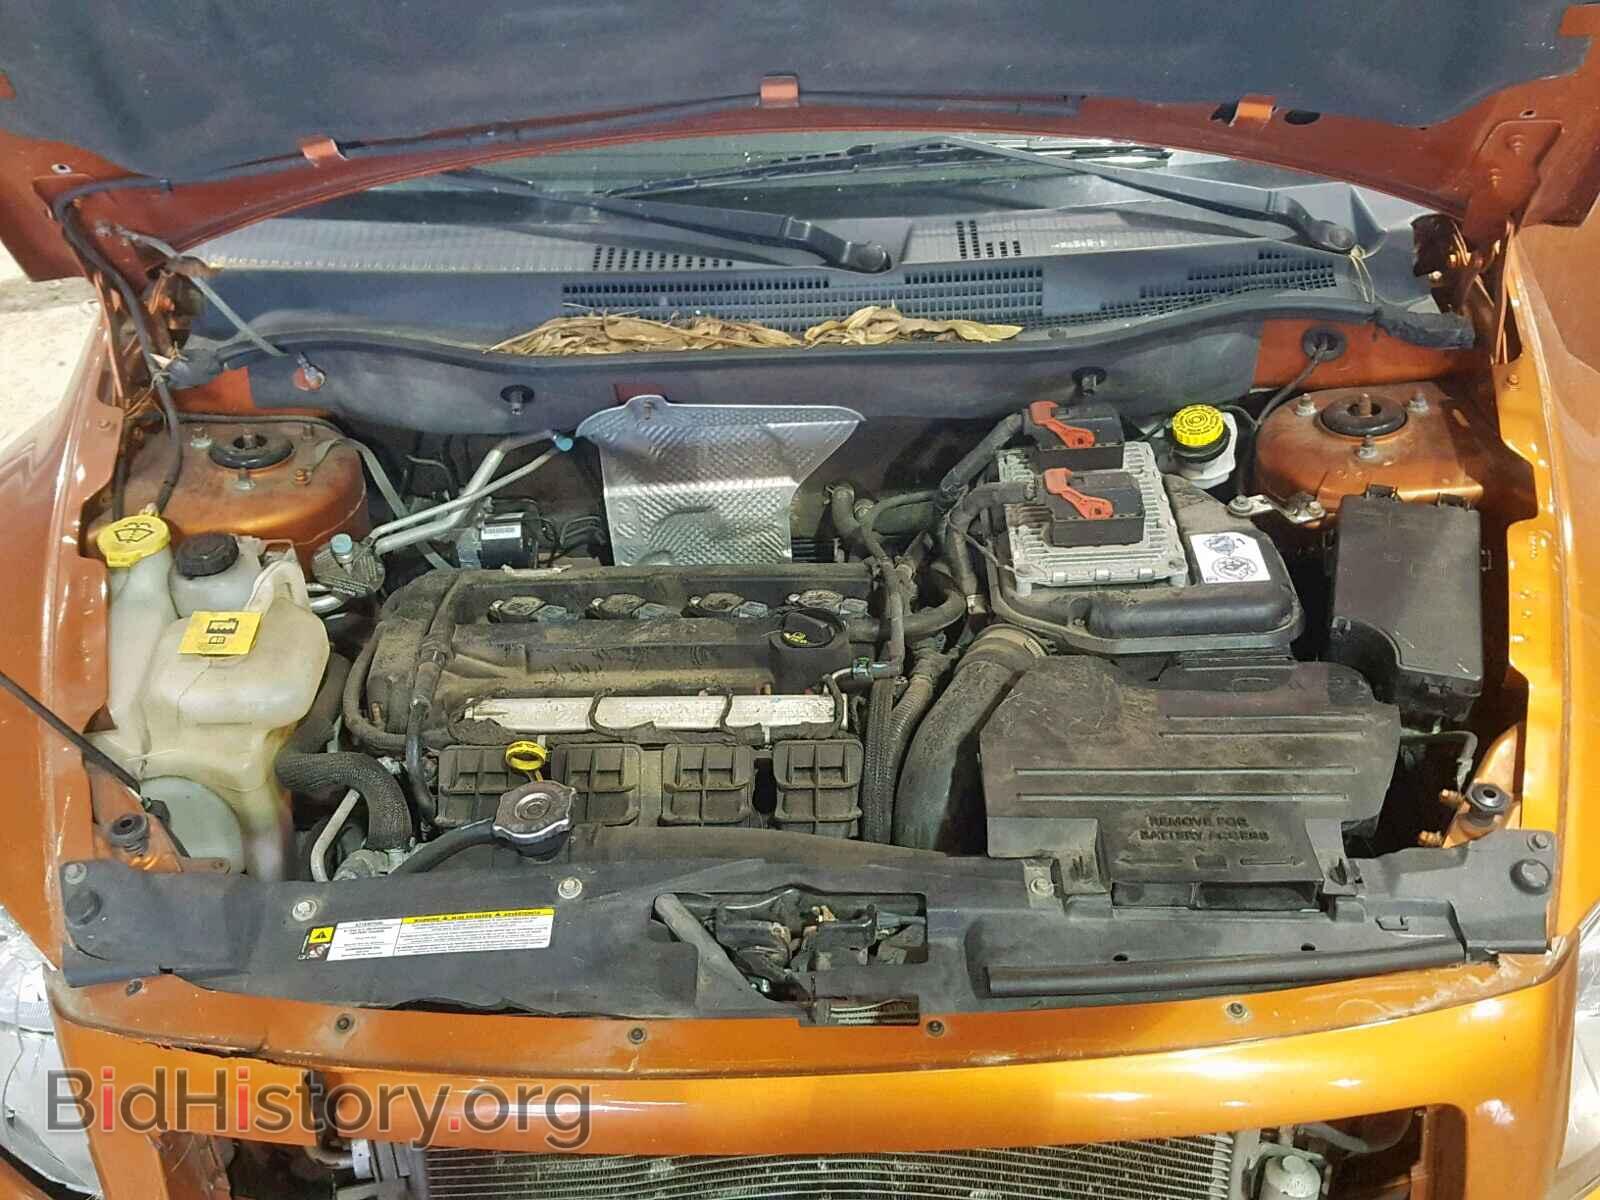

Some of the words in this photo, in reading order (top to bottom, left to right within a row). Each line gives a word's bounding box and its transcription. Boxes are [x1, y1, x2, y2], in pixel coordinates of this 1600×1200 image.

[1148, 815, 1213, 827] REMOVE
[1216, 815, 1249, 828] FOR
[1139, 830, 1202, 841] BATTERY
